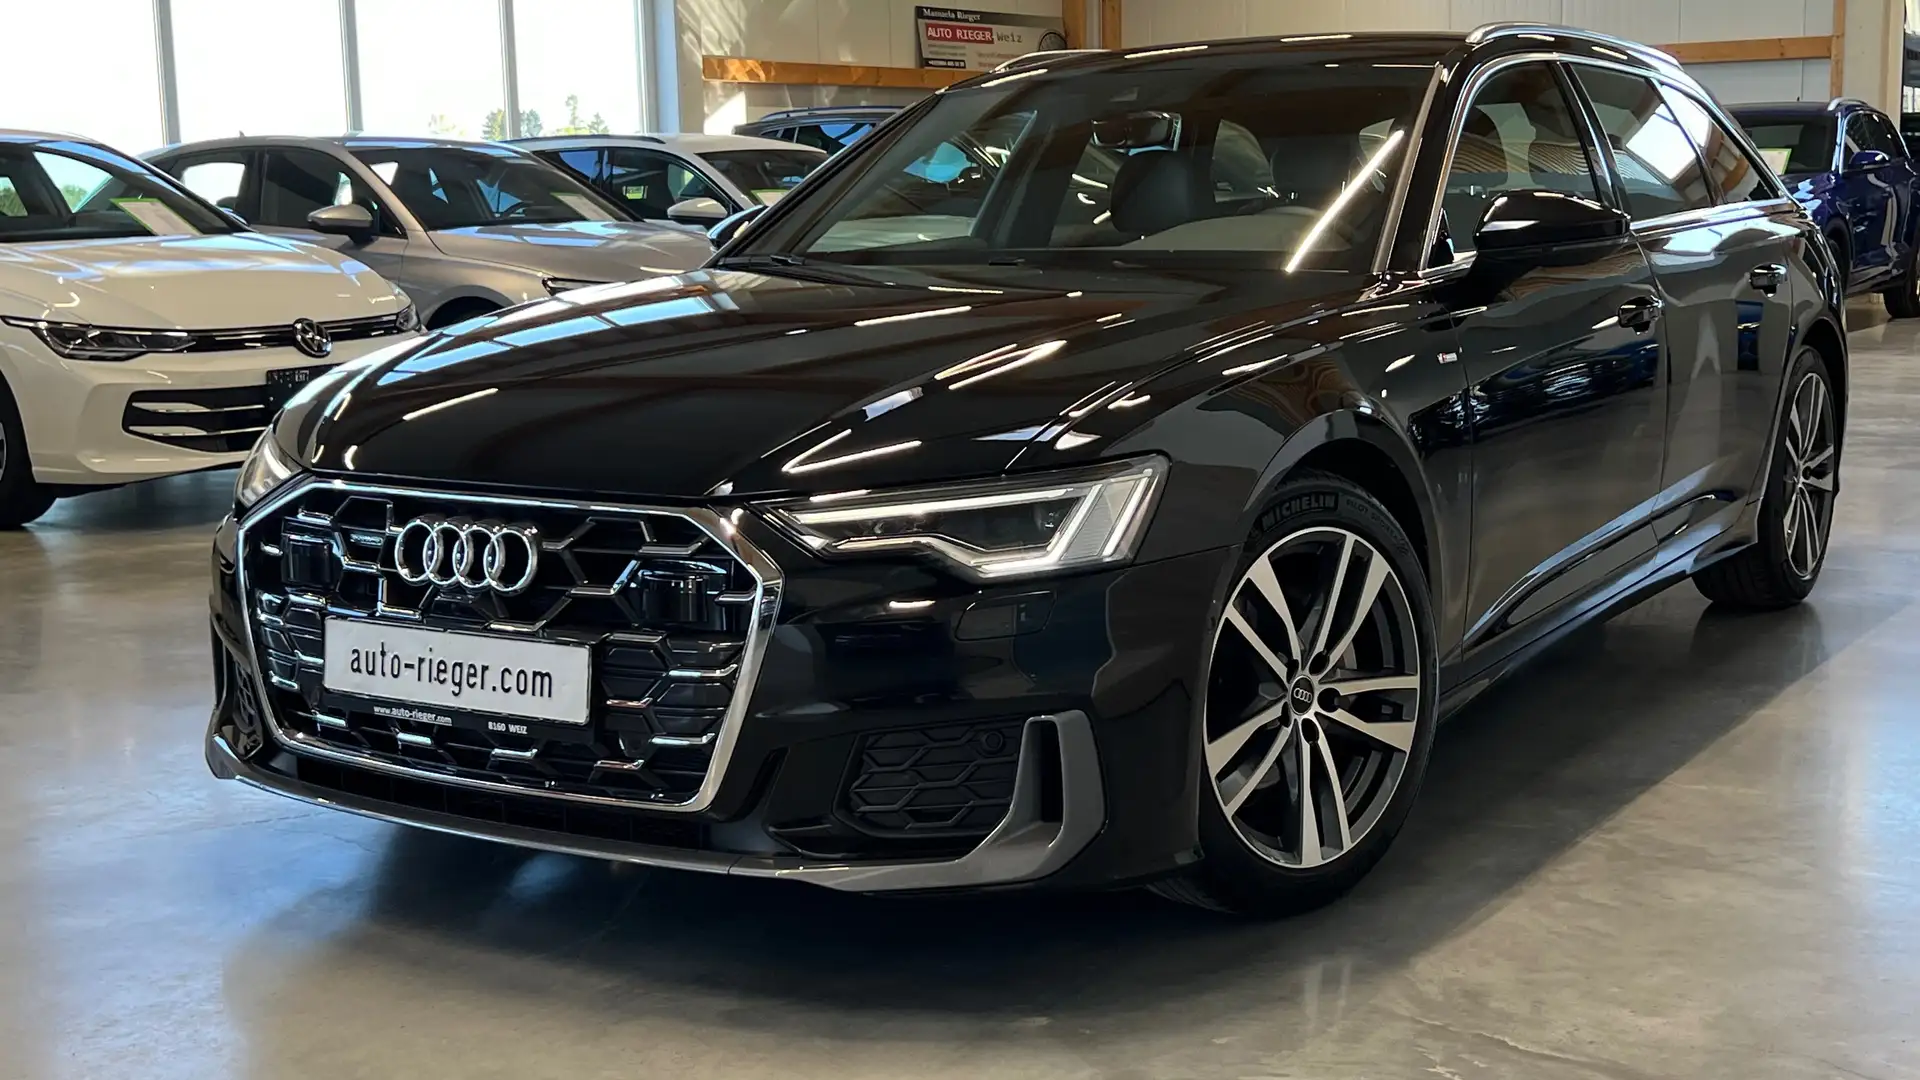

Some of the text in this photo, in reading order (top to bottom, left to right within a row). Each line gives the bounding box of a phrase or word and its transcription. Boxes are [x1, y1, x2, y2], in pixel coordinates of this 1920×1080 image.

[922, 8, 981, 22] Manuela Rieger
[927, 26, 1023, 44] AUTO RIEGER Weiz
[1261, 492, 1337, 530] MICHELIN
[350, 641, 553, 698] auto-rieger.com
[373, 705, 453, 725] www.auto-rieger.com
[487, 721, 528, 735] 8160 WEIZ
